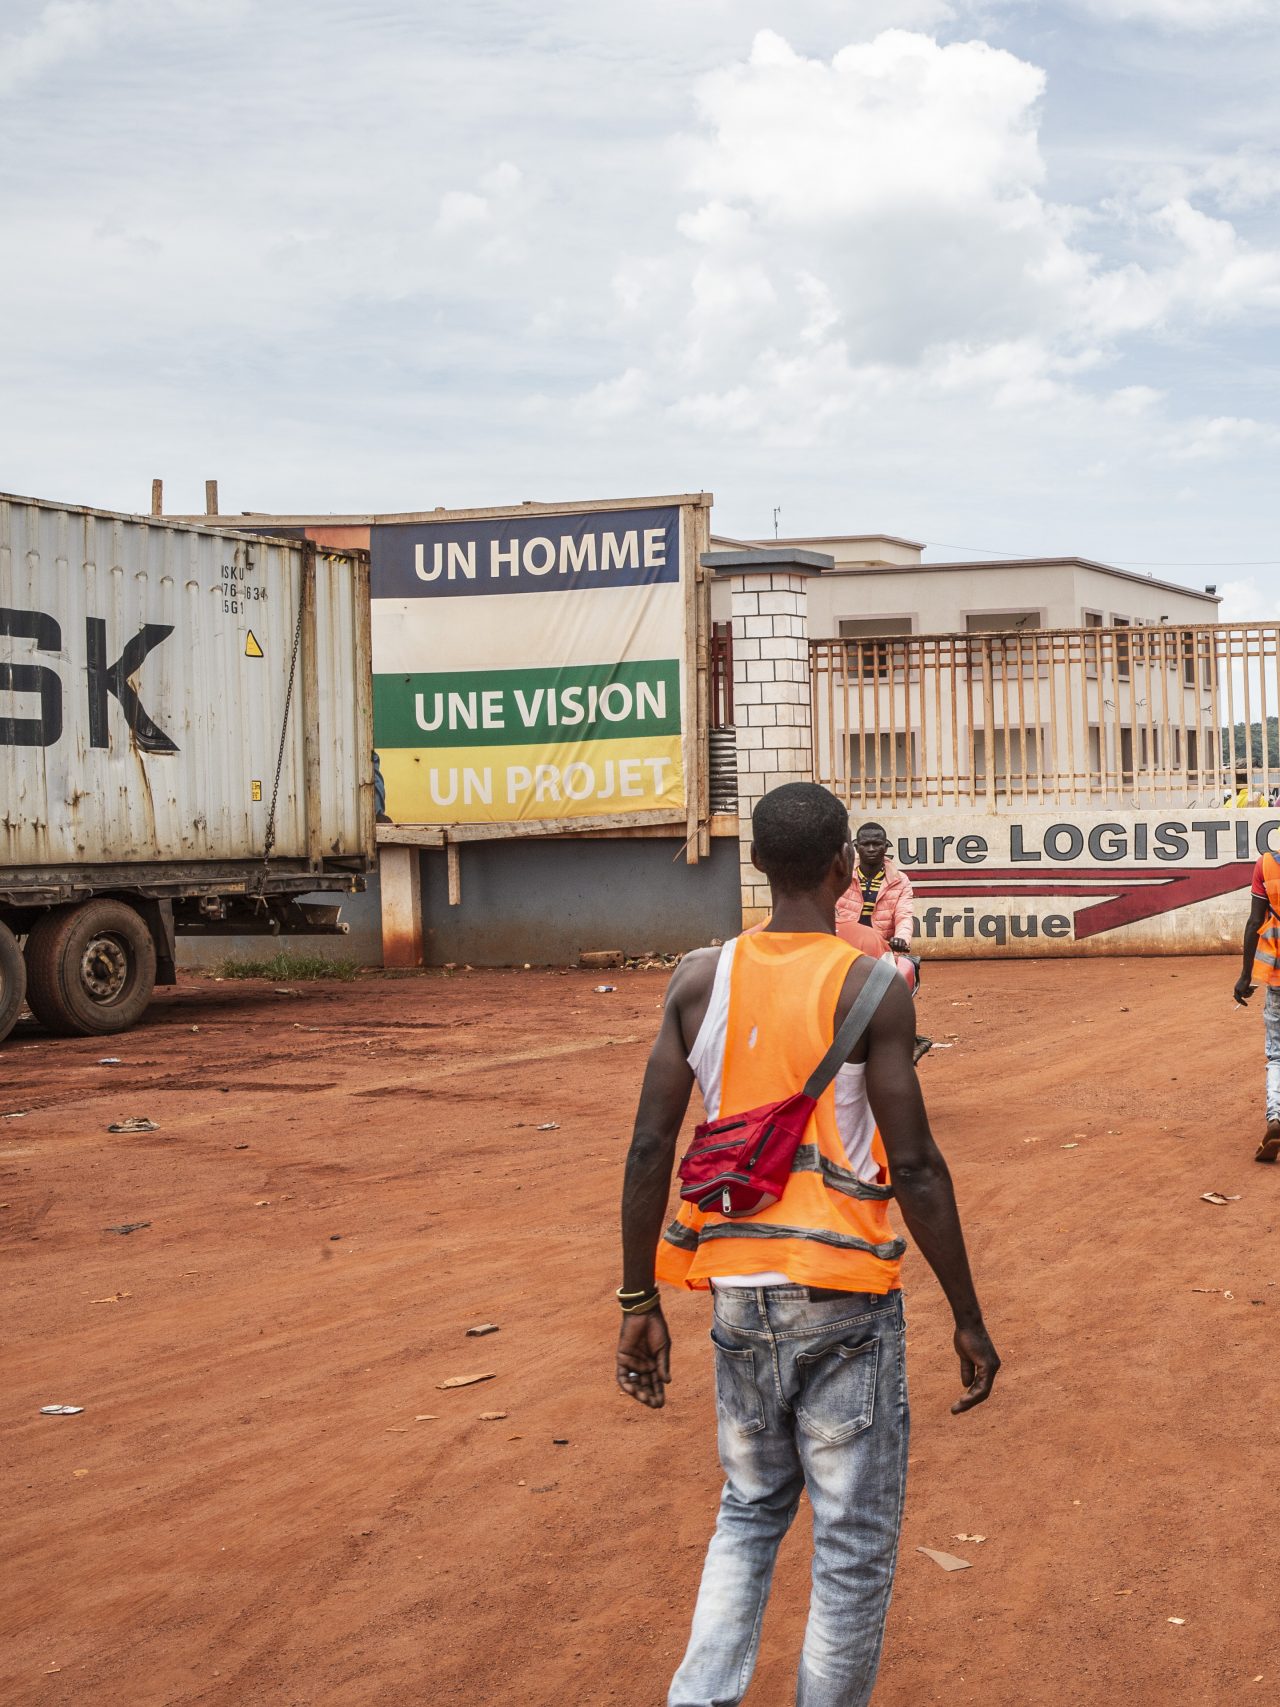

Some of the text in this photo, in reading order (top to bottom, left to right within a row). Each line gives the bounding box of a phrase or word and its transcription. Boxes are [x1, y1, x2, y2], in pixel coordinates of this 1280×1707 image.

[415, 528, 666, 582] UN HOMME
[414, 680, 667, 731] UNE VISION
[429, 756, 672, 806] UN PROJET
